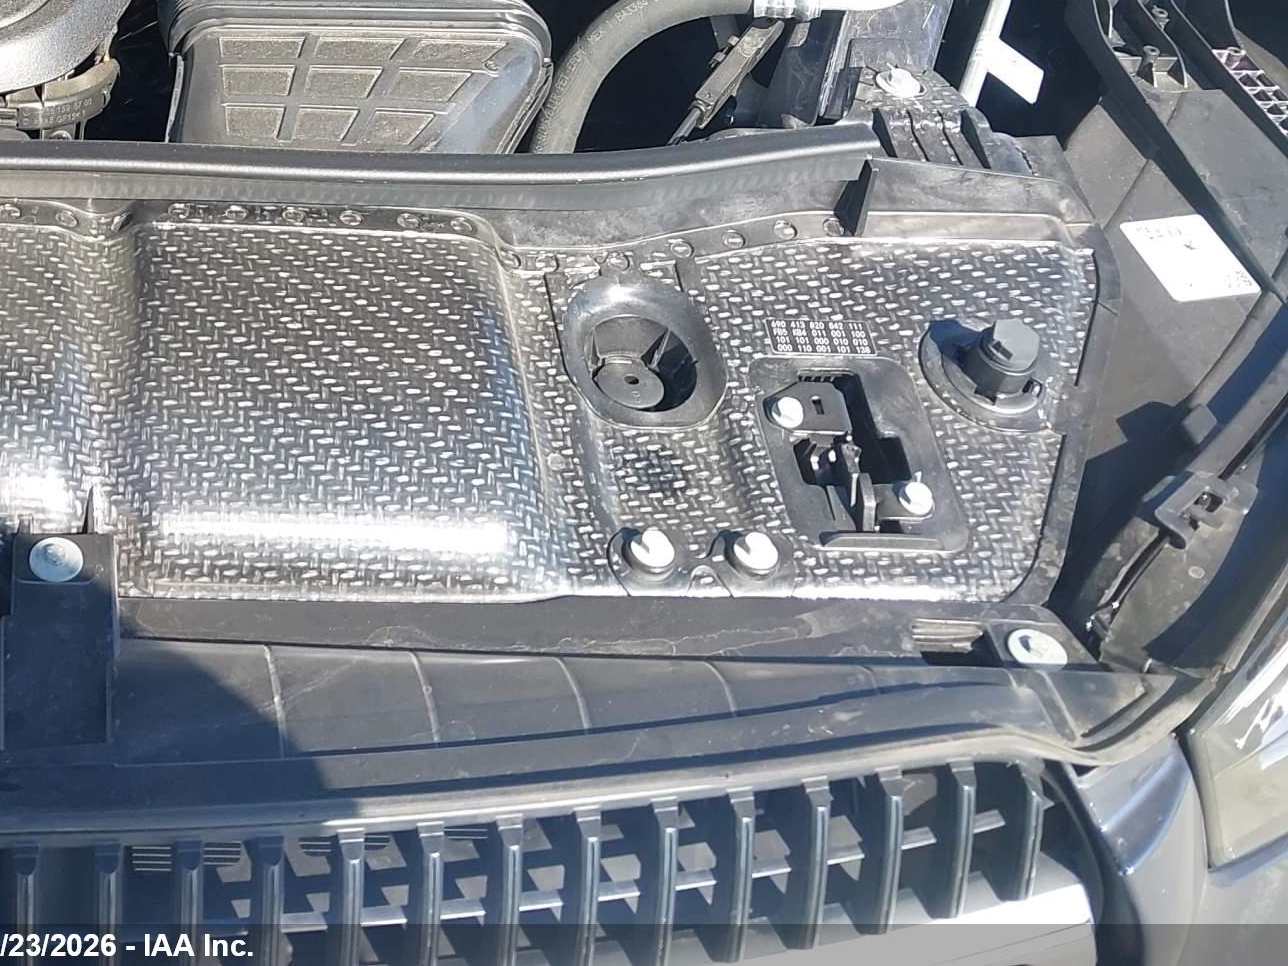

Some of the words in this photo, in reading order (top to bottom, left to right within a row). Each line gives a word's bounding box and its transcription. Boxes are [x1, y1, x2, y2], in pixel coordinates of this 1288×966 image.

[771, 320, 787, 328] 690
[830, 330, 846, 338] 001
[850, 330, 866, 338] 100
[776, 336, 790, 344] 101
[795, 336, 810, 344] 101
[813, 337, 830, 345] 000
[832, 338, 849, 346] 010
[852, 338, 868, 346] 010
[777, 344, 793, 352] 000
[797, 344, 812, 352] 110
[816, 345, 831, 353] 001
